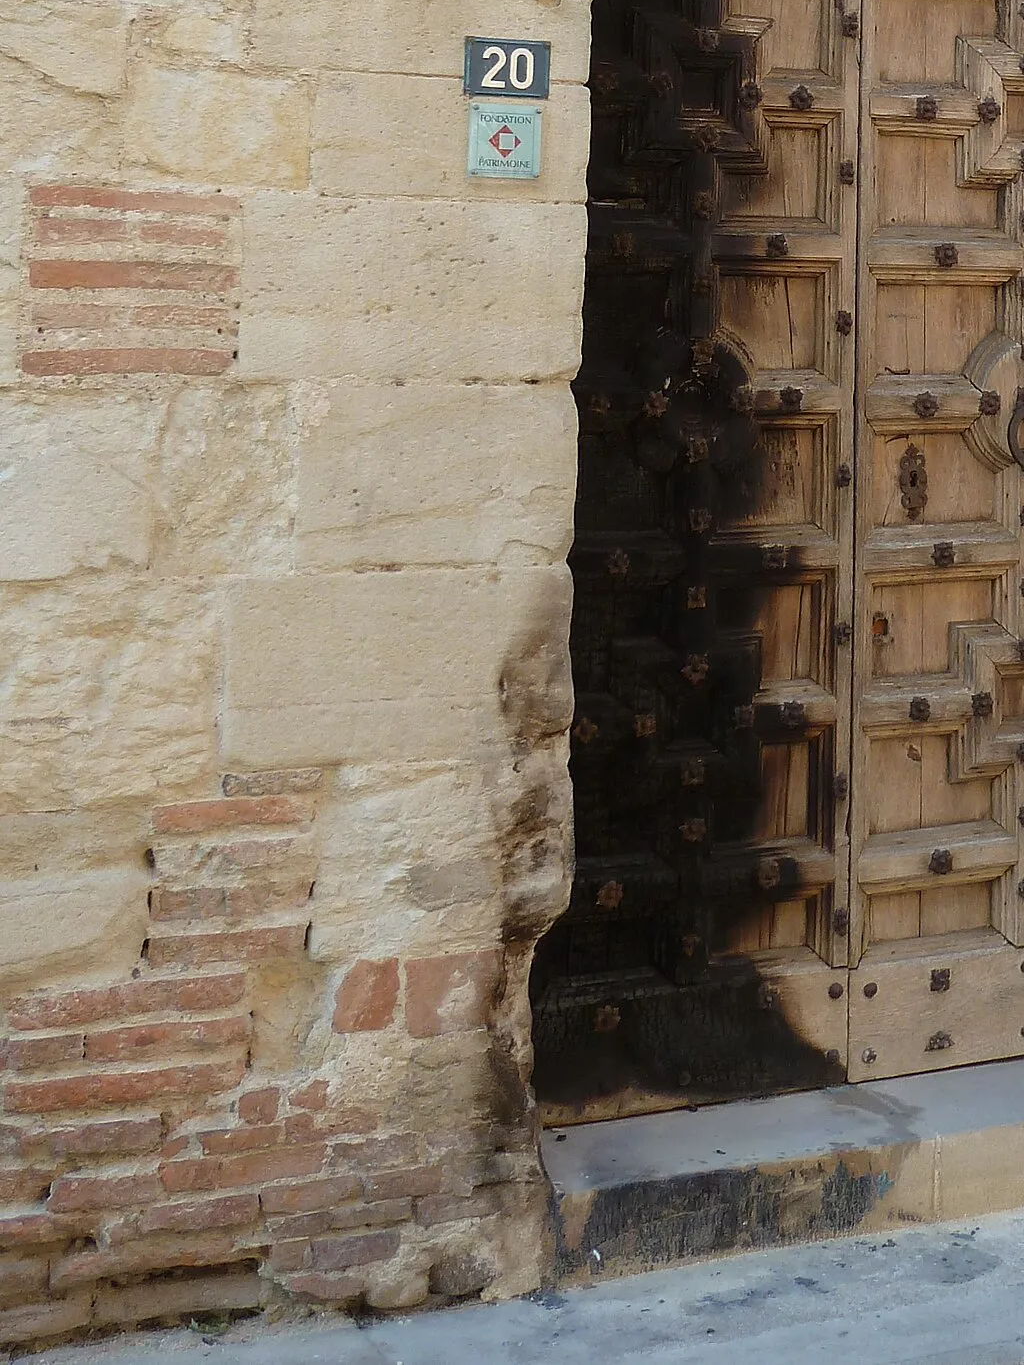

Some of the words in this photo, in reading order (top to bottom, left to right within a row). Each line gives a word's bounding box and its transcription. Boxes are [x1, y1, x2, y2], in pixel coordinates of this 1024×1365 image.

[481, 46, 534, 90] 20
[480, 114, 532, 125] FONDATION
[478, 156, 531, 169] PATRIMOINE
